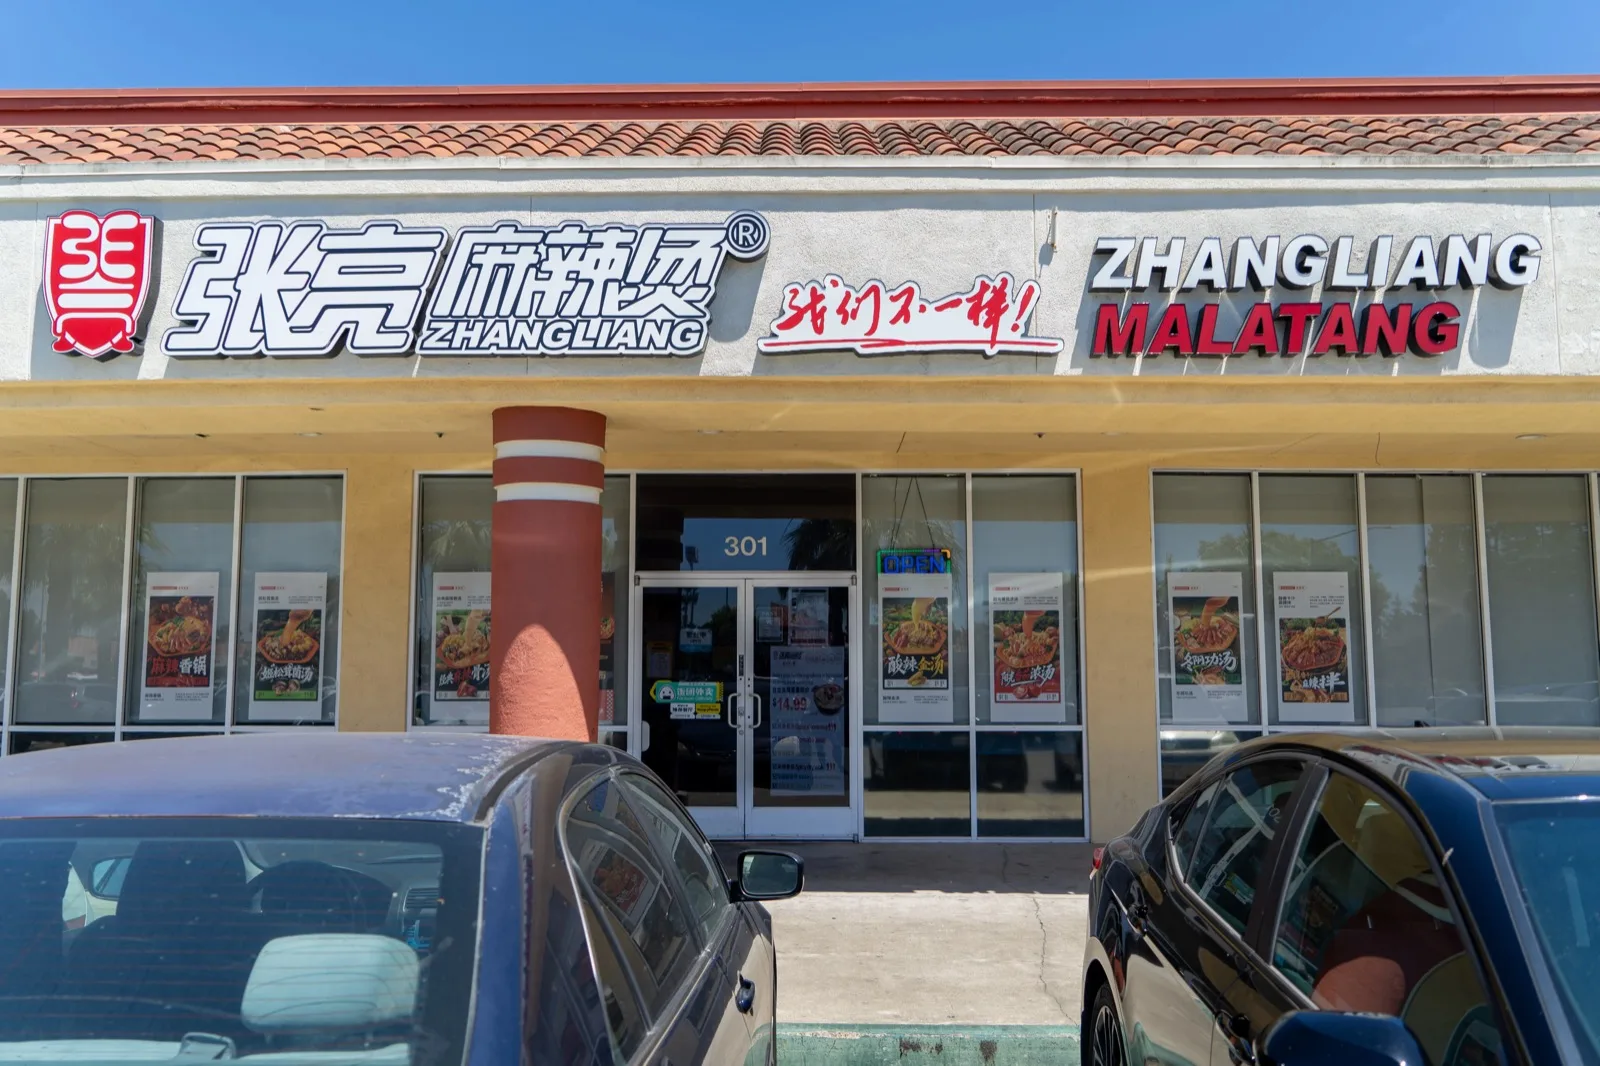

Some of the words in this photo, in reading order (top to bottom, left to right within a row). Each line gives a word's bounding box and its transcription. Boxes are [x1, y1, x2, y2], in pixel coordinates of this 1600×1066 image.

[1093, 234, 1541, 290] ZHANGLIANG
[165, 221, 728, 354] 张亮麻辣烫
[423, 320, 703, 350] ZHANGLIANG
[1091, 302, 1460, 358] MALATANG
[724, 536, 768, 557] 301
[884, 555, 945, 574] OPEN
